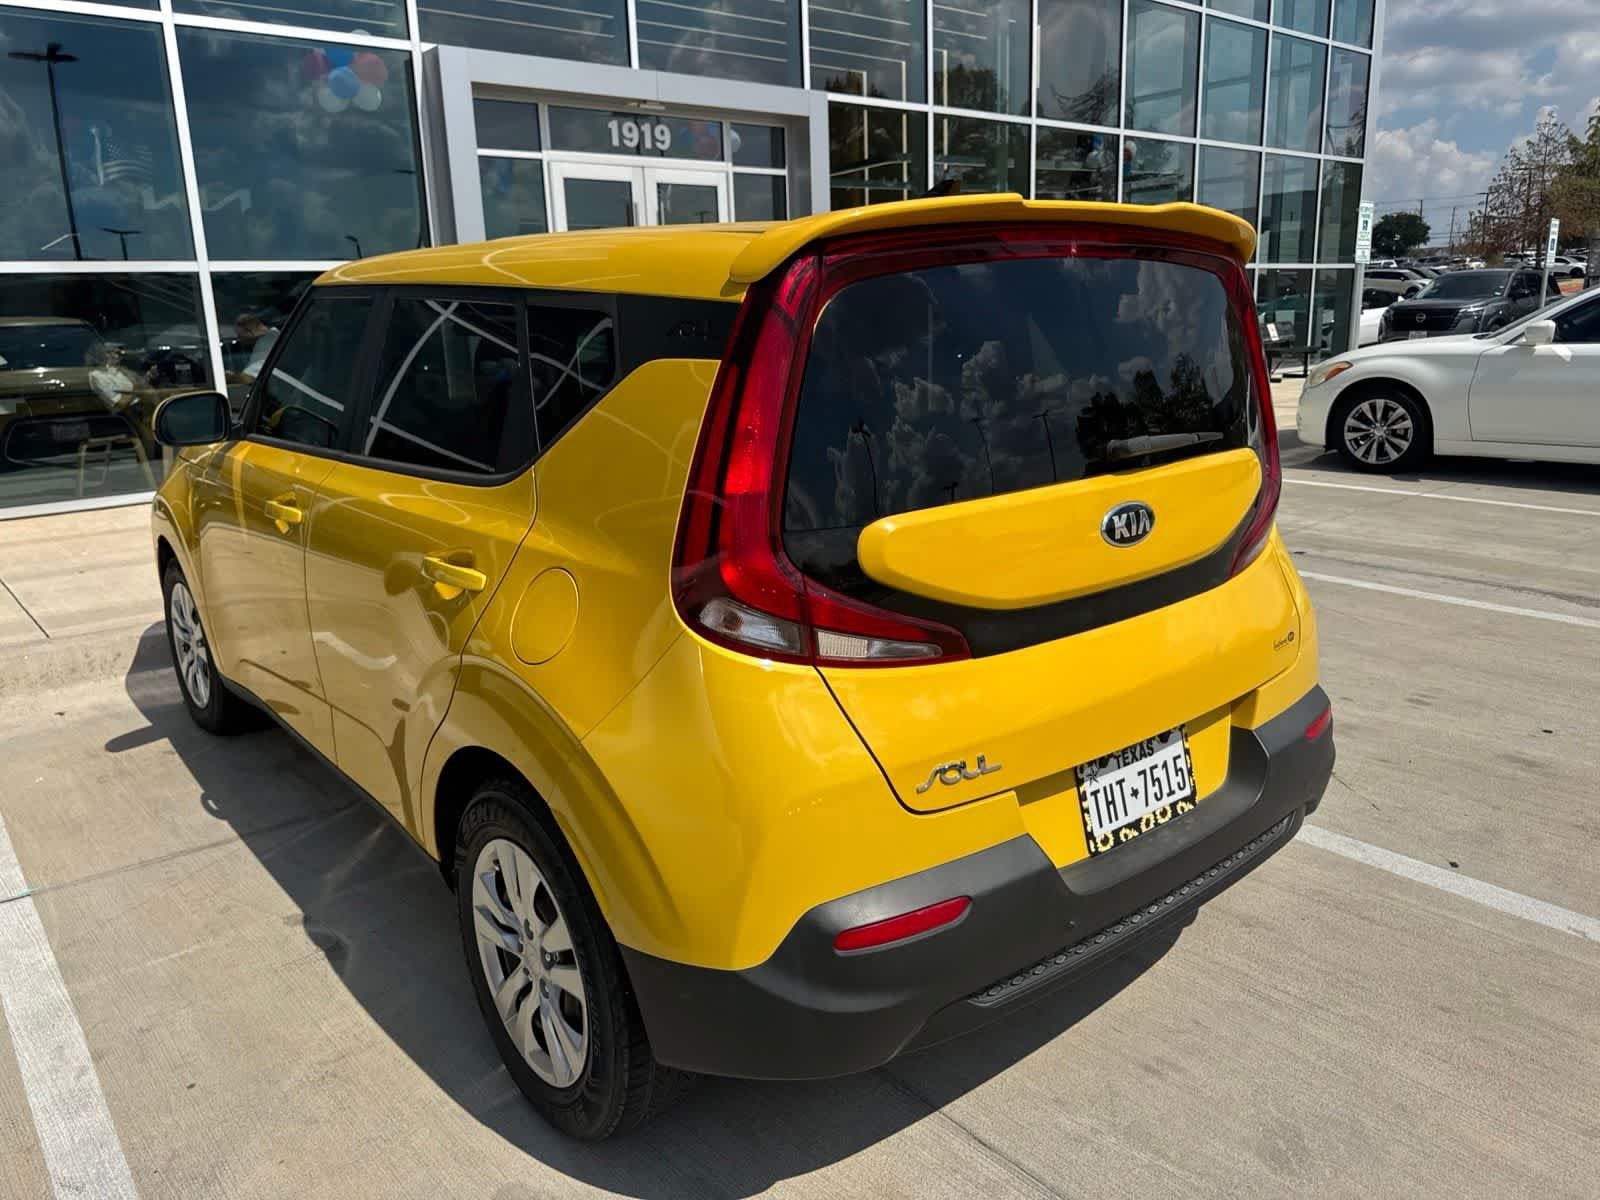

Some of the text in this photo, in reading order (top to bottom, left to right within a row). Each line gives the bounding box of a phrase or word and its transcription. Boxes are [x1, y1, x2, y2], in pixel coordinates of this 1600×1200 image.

[608, 119, 671, 151] 1919
[1112, 509, 1150, 539] KIA
[1114, 741, 1154, 769] TEXAS
[916, 753, 1002, 794] SOUL
[1137, 754, 1187, 808] 7515
